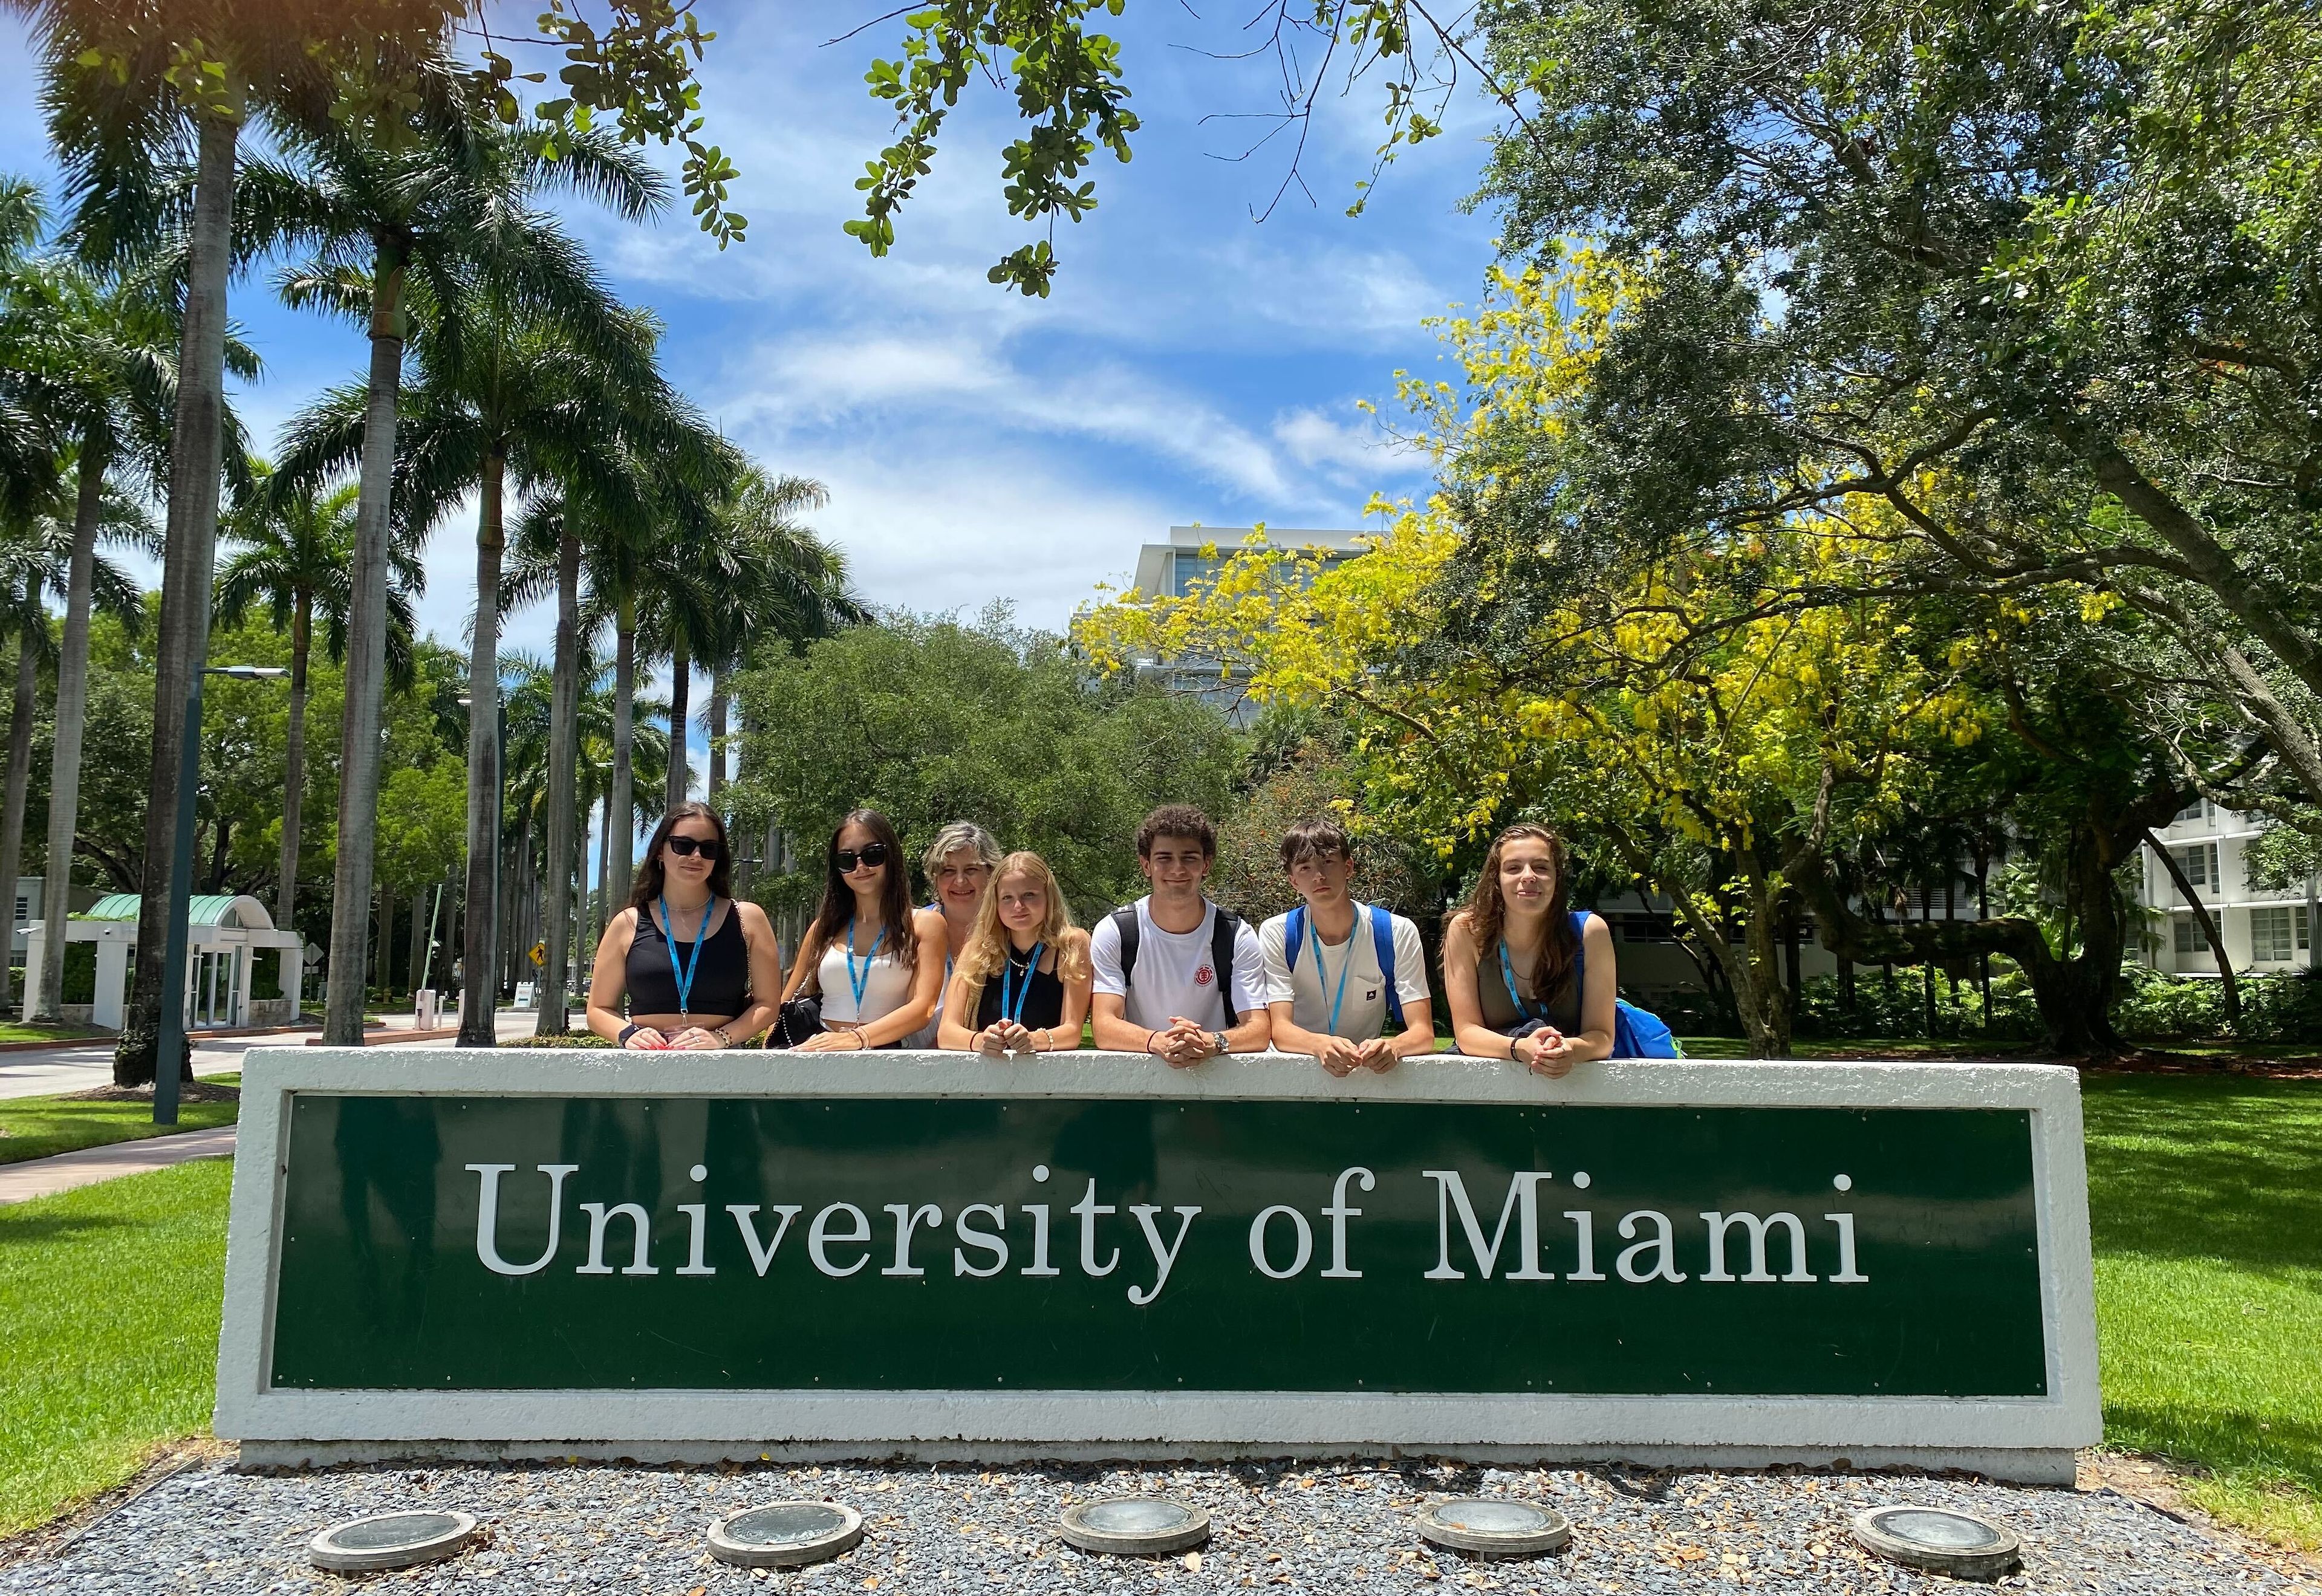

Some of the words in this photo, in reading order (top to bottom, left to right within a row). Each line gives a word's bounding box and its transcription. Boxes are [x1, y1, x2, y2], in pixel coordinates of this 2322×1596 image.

[465, 1164, 1202, 1305] University
[1250, 1167, 1376, 1279] of
[1423, 1171, 1869, 1282] Miami
